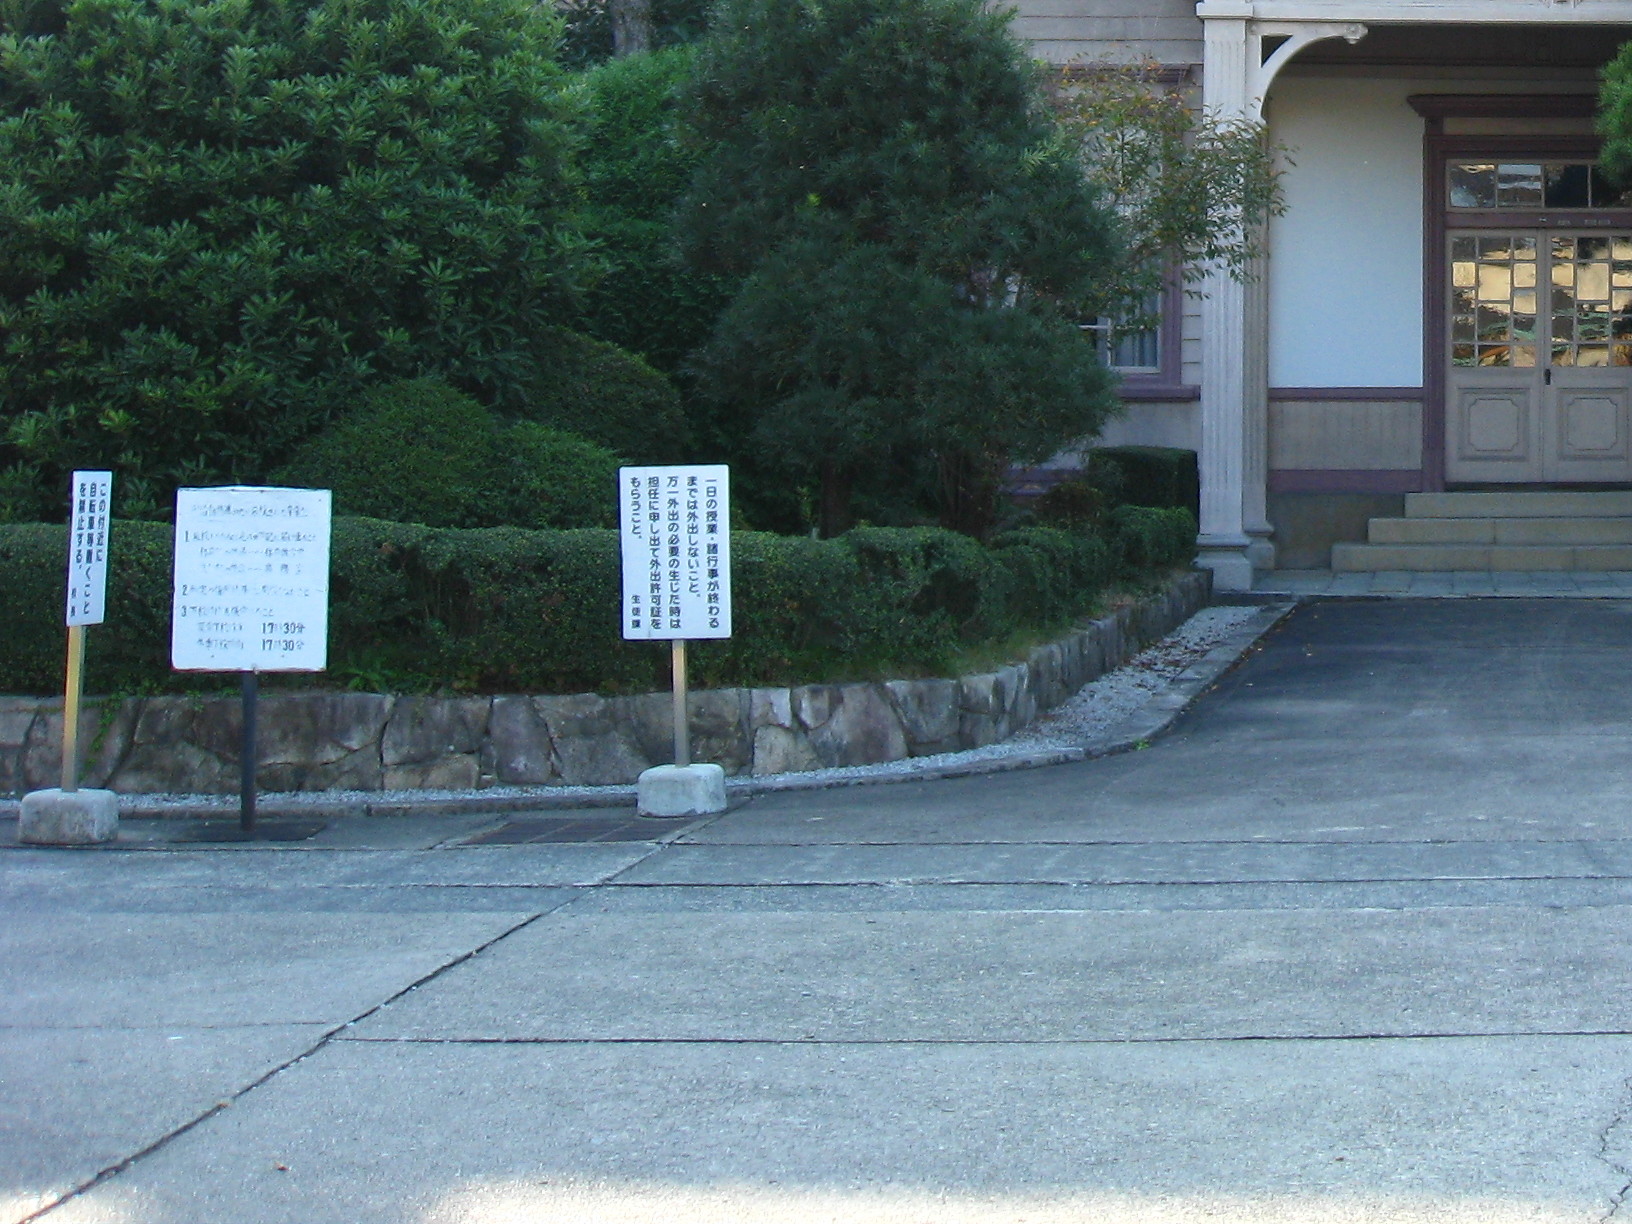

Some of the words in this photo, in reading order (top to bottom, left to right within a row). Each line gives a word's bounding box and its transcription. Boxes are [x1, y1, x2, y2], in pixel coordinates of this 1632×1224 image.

[630, 477, 642, 539] もらうこと。
[648, 476, 662, 630] 担任に申し出て外出許可証を
[667, 476, 681, 629] 万一外出の必要の生じた時は
[686, 476, 701, 598] までは外出しないこと。
[261, 622, 305, 634] 1730分
[261, 639, 305, 651] 1730分
